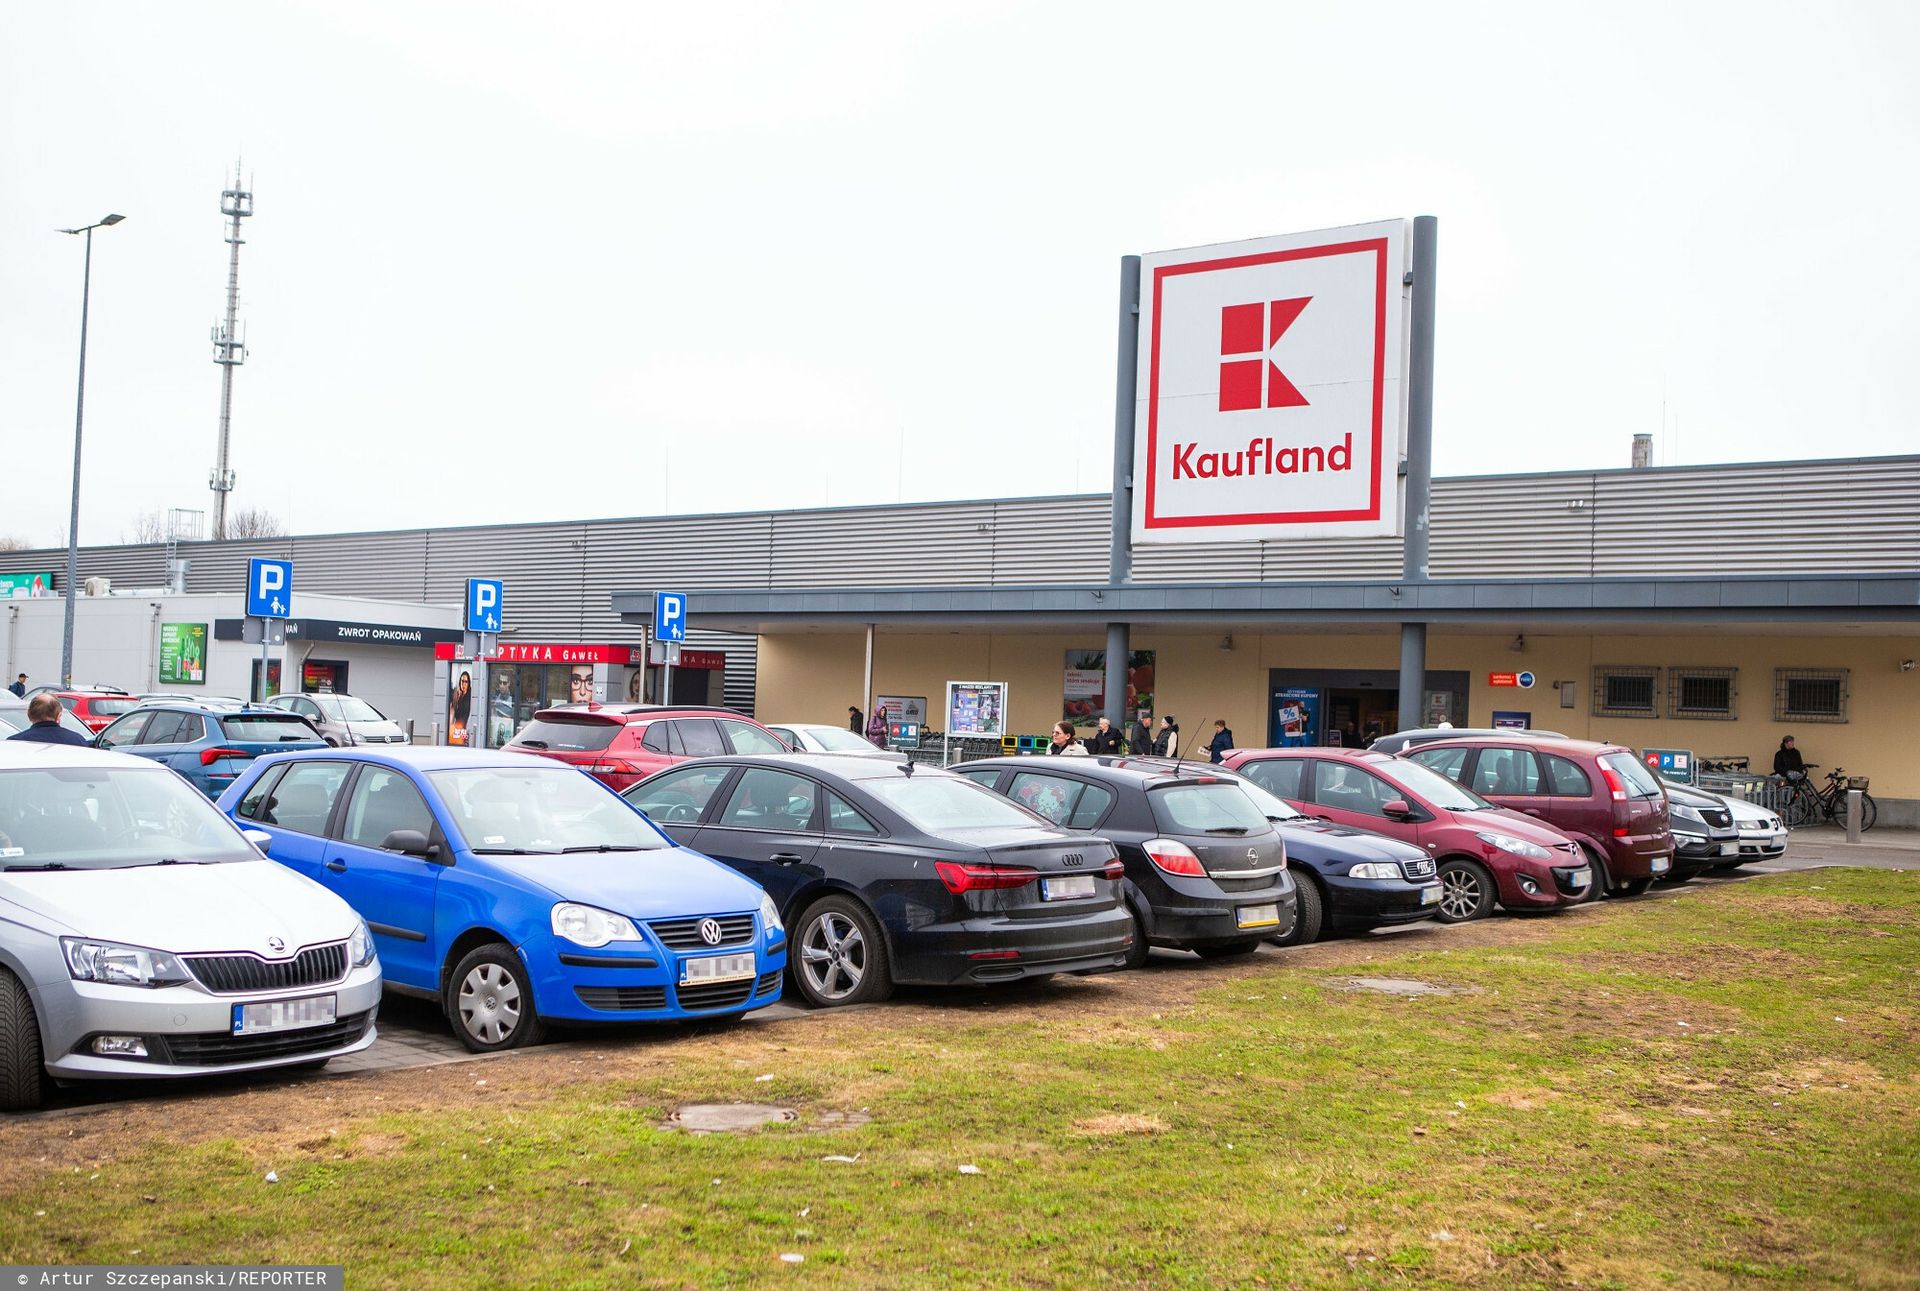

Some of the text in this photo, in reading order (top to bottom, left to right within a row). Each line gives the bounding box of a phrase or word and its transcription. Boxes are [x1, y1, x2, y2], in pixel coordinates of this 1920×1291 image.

[1173, 432, 1352, 480] Kaufland
[259, 564, 284, 600] P
[476, 583, 496, 616] P
[663, 596, 680, 627] P
[338, 627, 421, 641] ZWROT OPAKOWAŃ
[562, 649, 599, 661] GAWEŁ
[1663, 755, 1671, 766] P
